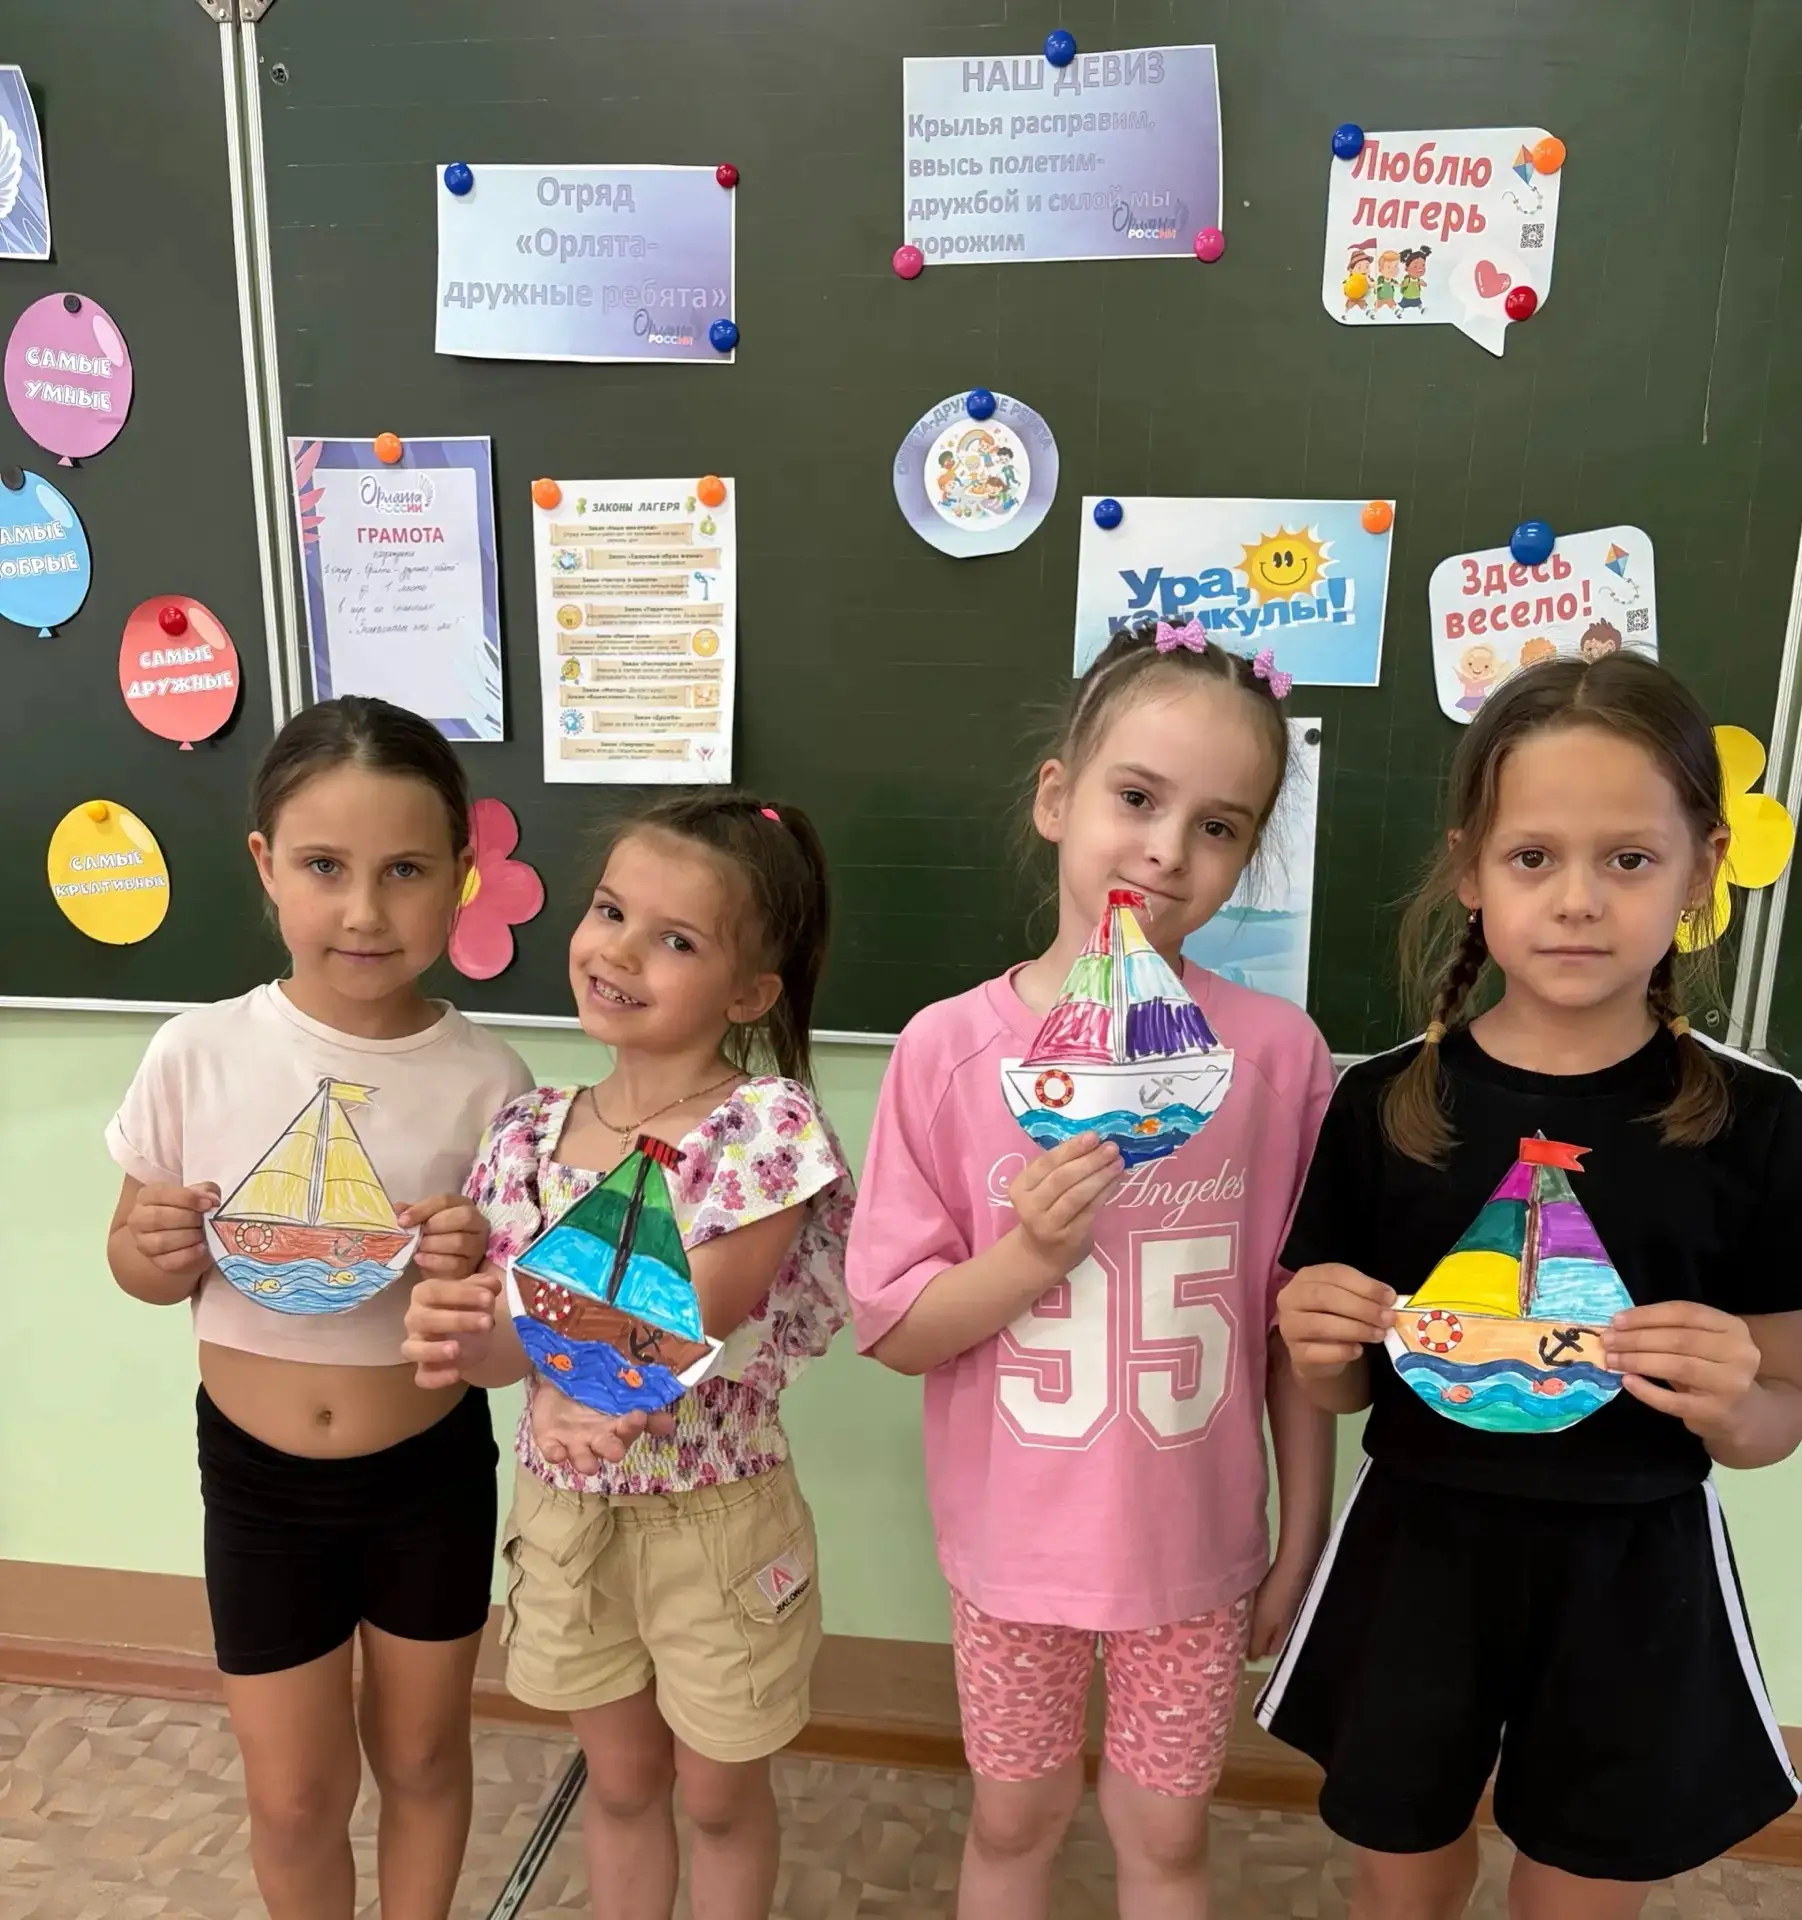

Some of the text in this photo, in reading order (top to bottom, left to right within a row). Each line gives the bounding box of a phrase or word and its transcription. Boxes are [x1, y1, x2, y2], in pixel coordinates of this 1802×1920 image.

[962, 51, 1165, 97] НАШ ДЕВИЗ
[908, 110, 1156, 142] Крылья расправим,
[908, 153, 1105, 177] ввысь полетим-
[1351, 140, 1493, 188] Люблю
[537, 176, 635, 213] Отряд
[908, 185, 1171, 222] дружбой и силой мы
[1352, 197, 1487, 242] лагерь
[515, 228, 659, 264] «Орлята-
[443, 278, 728, 313] дружные ребята»
[25, 346, 113, 378] САМЫЕ
[24, 380, 112, 413] УМНЫЕ
[592, 502, 681, 513] ЗАКОНЫ ЛАГЕРЯ
[0, 520, 66, 546] АМЫЕ
[357, 527, 445, 544] ГРАМОТА
[0, 551, 80, 579] ОБРЫЕ
[1461, 553, 1572, 597] Здесь
[1118, 566, 1251, 614] Ура,
[1445, 579, 1593, 640] весело!
[140, 644, 214, 669] САМЫЕ
[127, 670, 235, 699] ДРУЖНЫЕ
[70, 850, 144, 872] САМЫЕ
[54, 875, 166, 898] КРЕАТИВНЫЕ
[1105, 1156, 1246, 1229] Angeles
[994, 1222, 1239, 1450] 95
[770, 1563, 793, 1595] A
